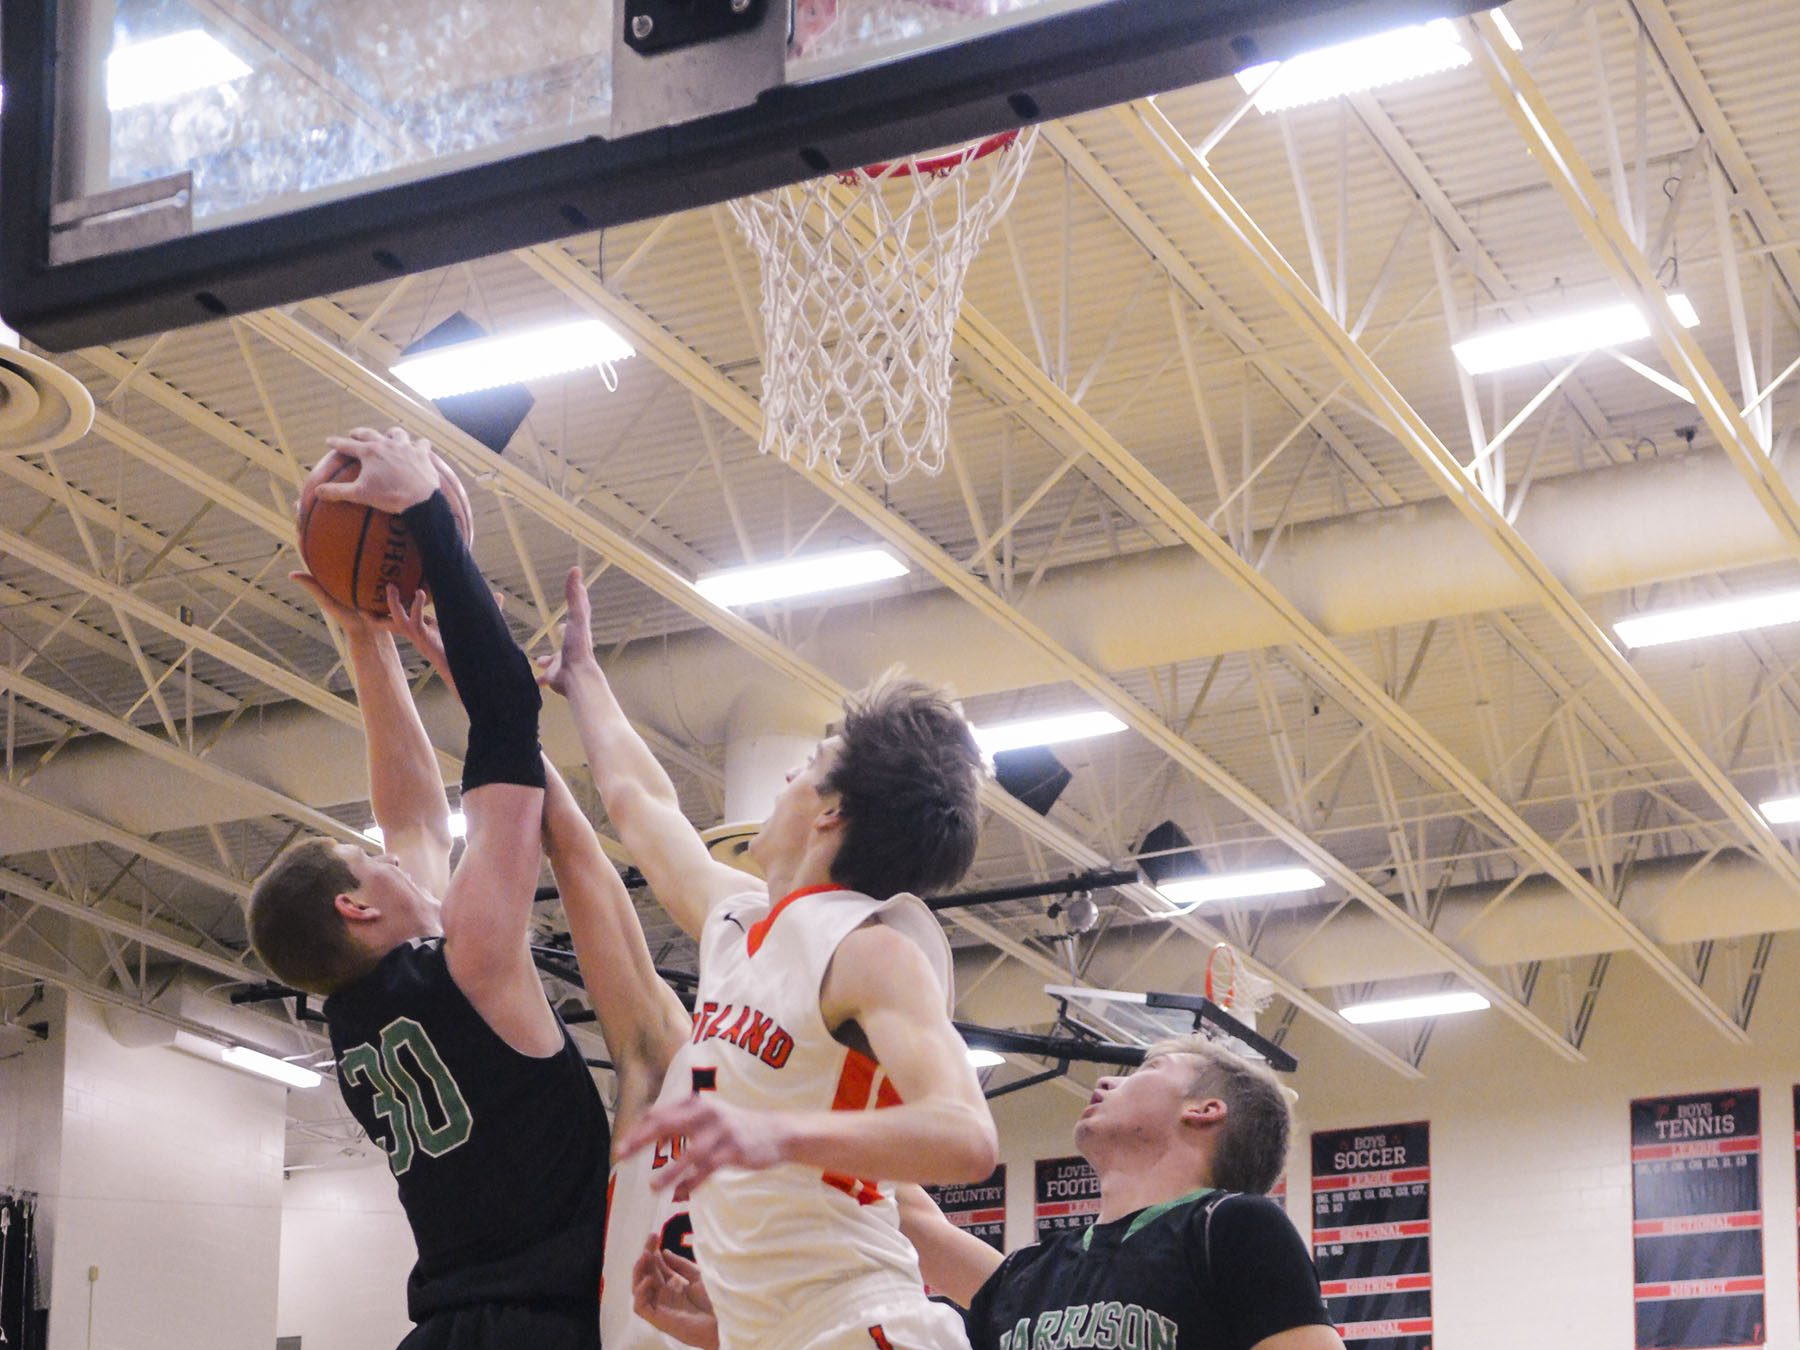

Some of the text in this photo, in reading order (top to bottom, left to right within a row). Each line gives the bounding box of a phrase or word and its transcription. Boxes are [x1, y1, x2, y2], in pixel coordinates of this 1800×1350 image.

[339, 1016, 473, 1177] 30
[1677, 1103, 1713, 1118] BOYS
[1655, 1115, 1736, 1139] TENNIS
[1354, 1135, 1386, 1150] BOYS
[1334, 1146, 1407, 1170] SOCCER
[1058, 1164, 1096, 1179] LOVEL
[945, 1187, 1003, 1204] COUNTRY
[1047, 1177, 1101, 1197] FOOTB
